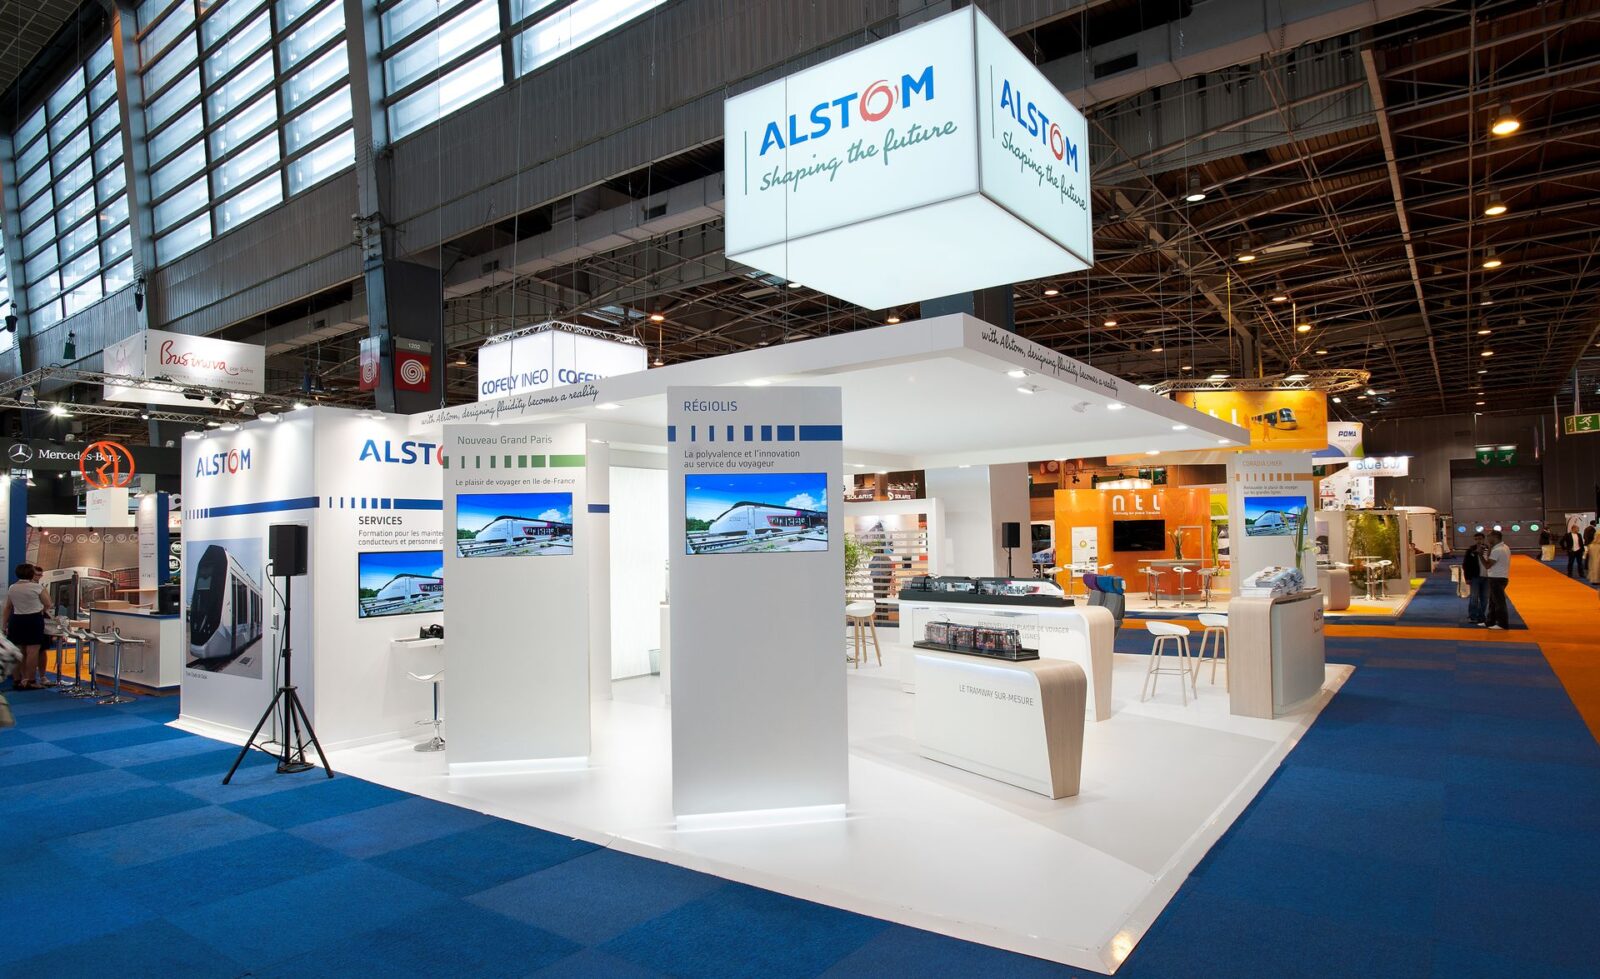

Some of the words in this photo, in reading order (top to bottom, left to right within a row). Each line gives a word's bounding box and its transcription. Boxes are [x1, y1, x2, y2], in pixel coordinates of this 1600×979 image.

[759, 65, 935, 156] ALSTOM
[1000, 79, 1078, 173] ALSTOM
[760, 153, 843, 192] Shaping
[848, 138, 879, 163] the
[883, 121, 958, 166] future
[1002, 132, 1044, 187] Shaping
[1046, 164, 1060, 188] the
[1060, 174, 1086, 210] future
[982, 328, 998, 344] with
[1000, 334, 1025, 358] Alstom,
[1028, 344, 1056, 374] designing
[1058, 355, 1078, 382] fluidity
[1080, 366, 1098, 384] becomes
[1102, 378, 1118, 398] reality
[482, 374, 519, 395] COFELY
[522, 368, 549, 388] INEO
[558, 368, 602, 384] COFE
[422, 414, 436, 424] with
[436, 410, 460, 424] Alstom,
[462, 404, 496, 422] designing
[496, 398, 526, 418] fluidity
[528, 395, 558, 407] becomes
[569, 384, 599, 402] reality
[684, 398, 738, 412] RÉGIOLIS
[458, 436, 498, 445] Nouveau
[500, 435, 527, 444] Grand
[530, 434, 552, 444] Paris
[38, 449, 122, 462] Merceds-Bnz
[196, 448, 251, 478] ALSTOM
[696, 450, 742, 459] polyvalence
[754, 449, 800, 458] l'innovation
[739, 460, 775, 469] voyageur
[1112, 494, 1160, 511] ntl
[358, 516, 403, 525] SERVICES
[408, 538, 438, 546] personnel
[967, 685, 993, 698] TRAMWAY
[995, 691, 1034, 706] SUR-MESURE
